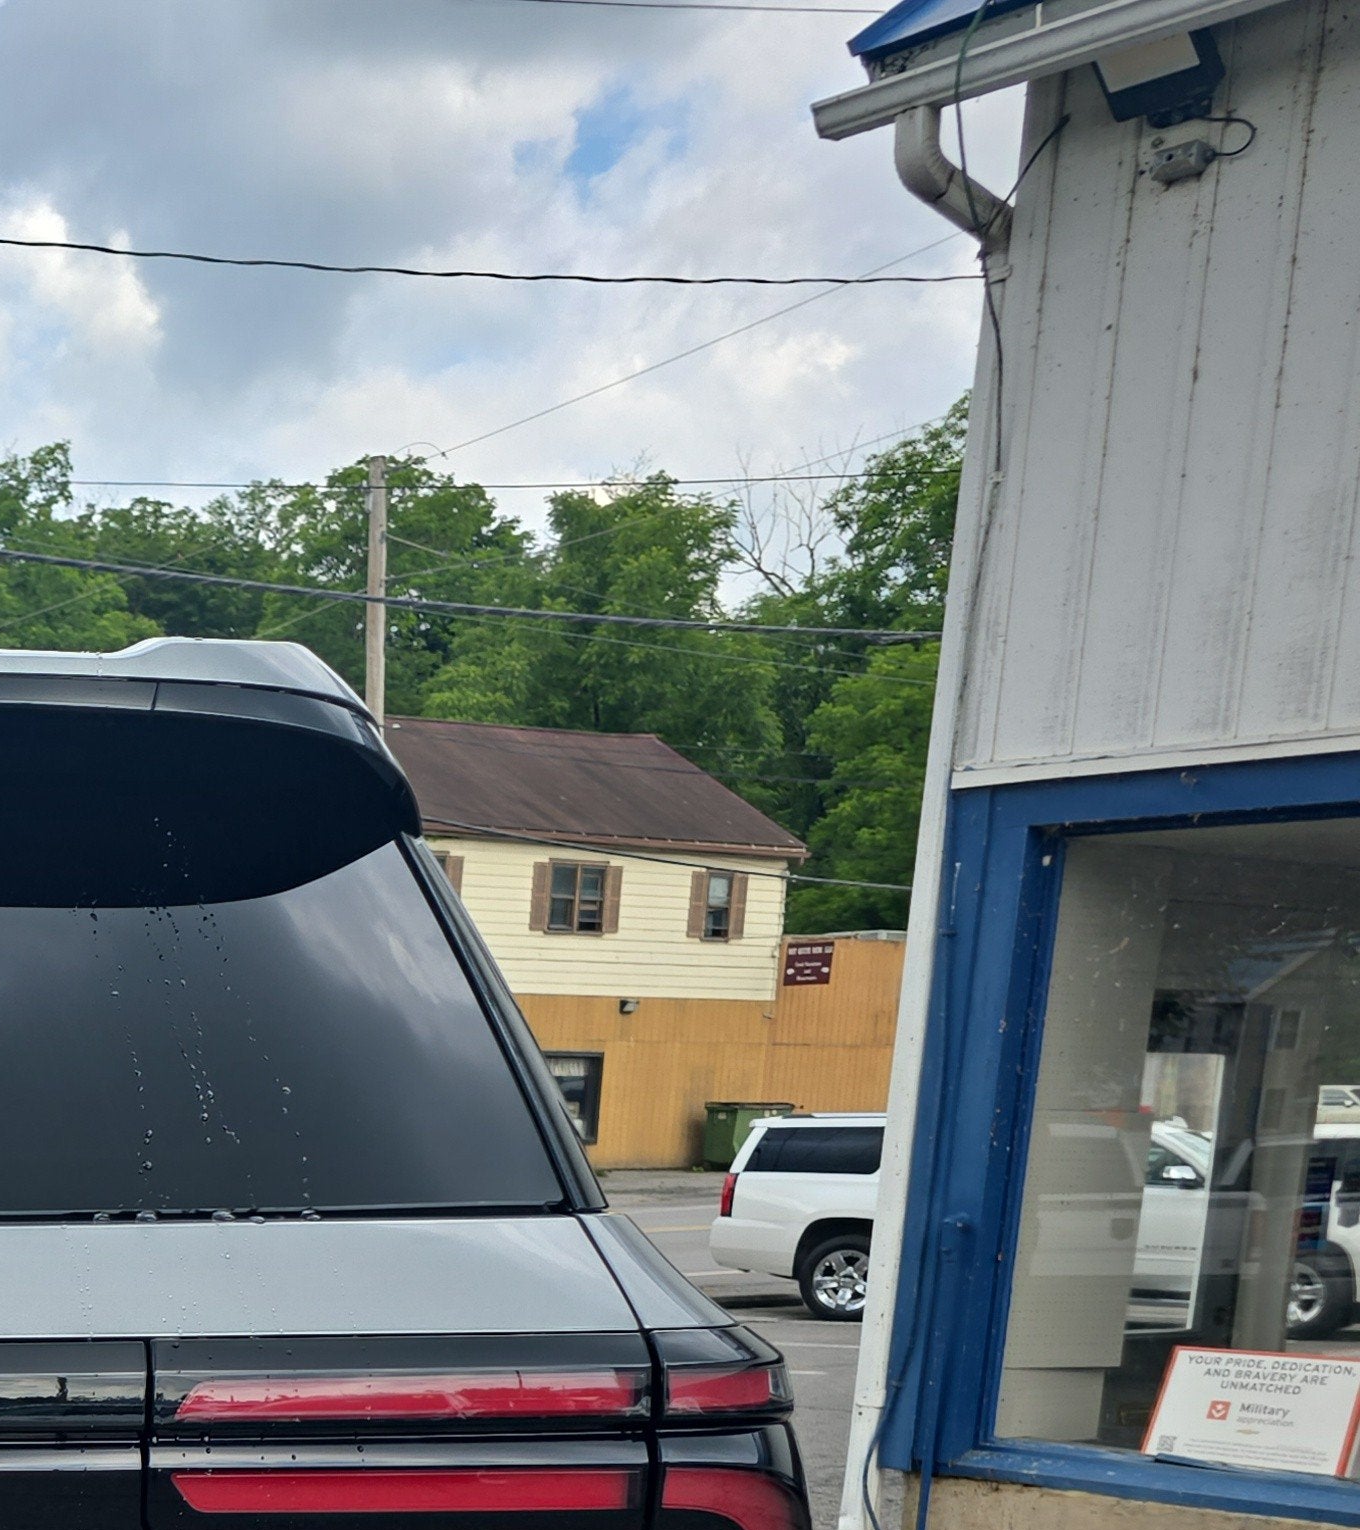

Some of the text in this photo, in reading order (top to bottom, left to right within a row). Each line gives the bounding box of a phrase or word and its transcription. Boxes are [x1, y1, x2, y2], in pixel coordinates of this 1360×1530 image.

[1188, 1355, 1223, 1366] YOUR
[1203, 1368, 1329, 1386] AND BRAVERY ARE
[1220, 1381, 1302, 1395] UNMATCHED
[1238, 1403, 1291, 1419] Military
